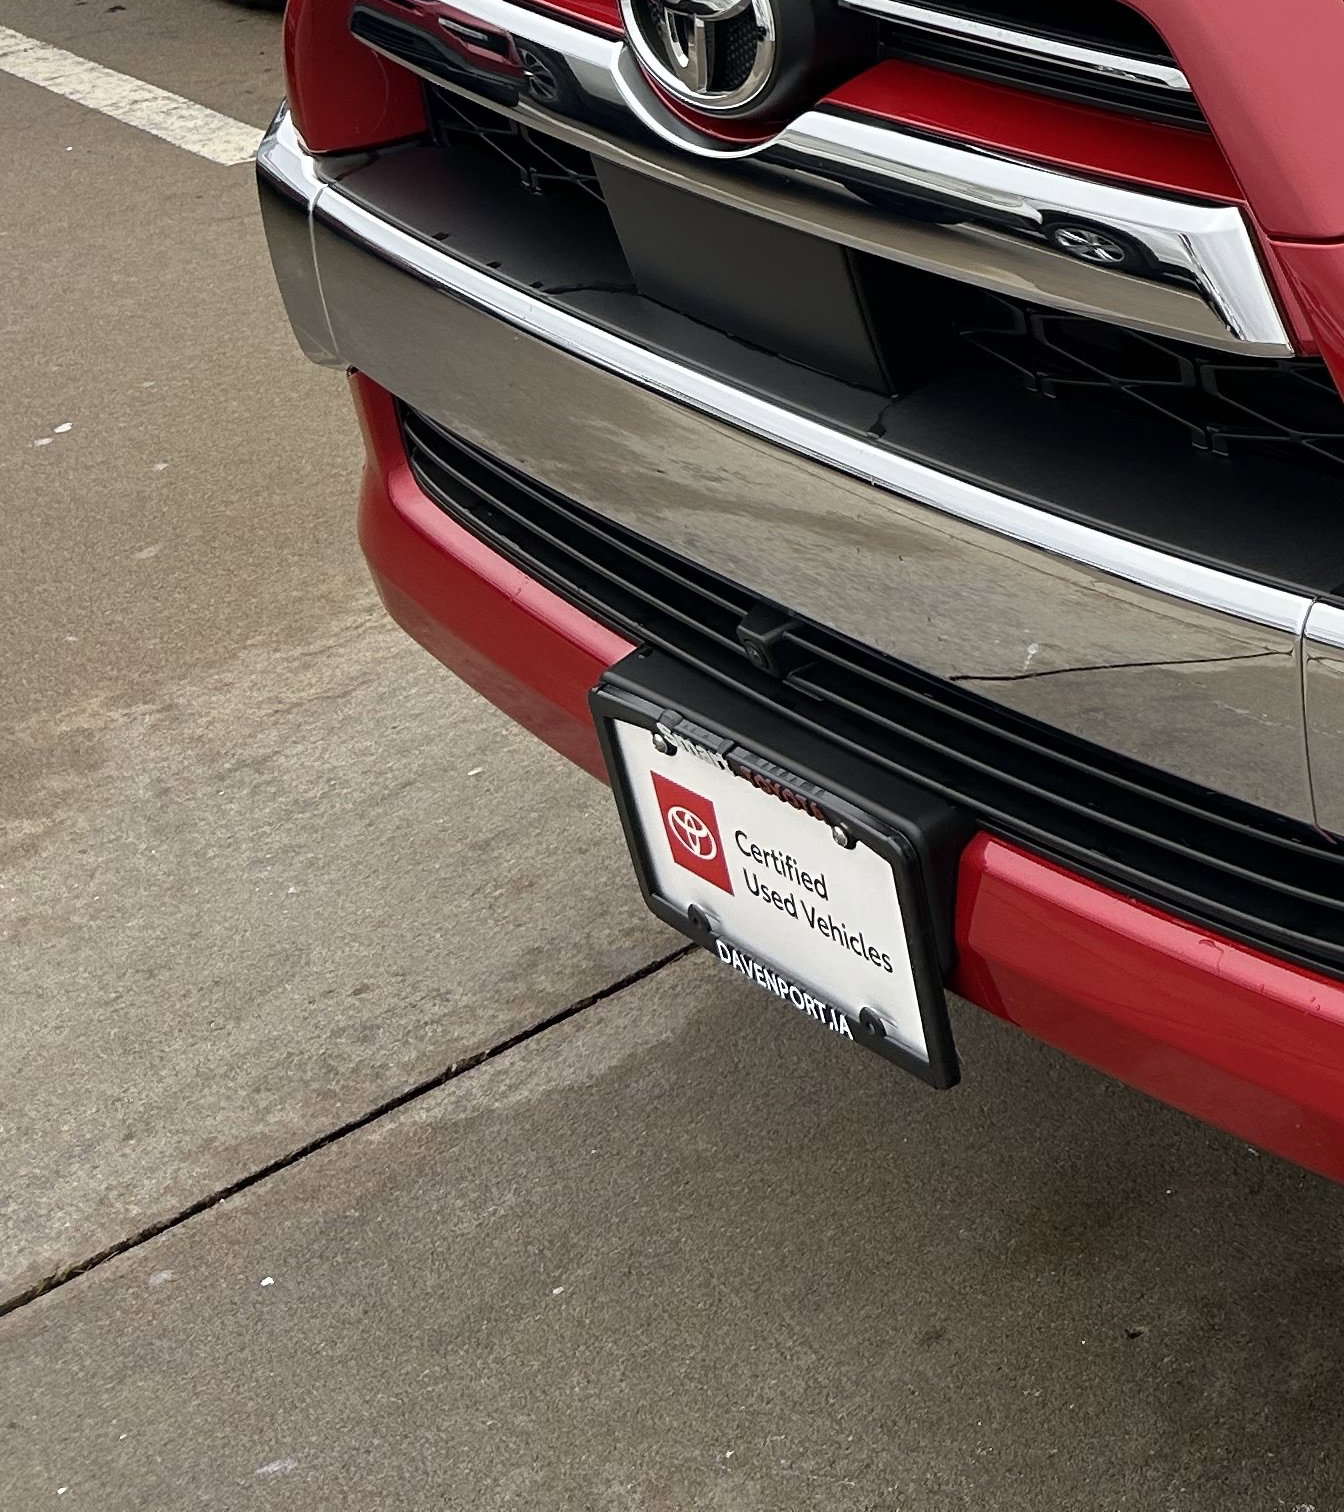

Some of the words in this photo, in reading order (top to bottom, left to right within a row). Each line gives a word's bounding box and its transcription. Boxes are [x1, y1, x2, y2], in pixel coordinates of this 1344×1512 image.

[735, 829, 829, 901] Certified
[742, 867, 799, 920] Used
[800, 899, 894, 974] Vehicles
